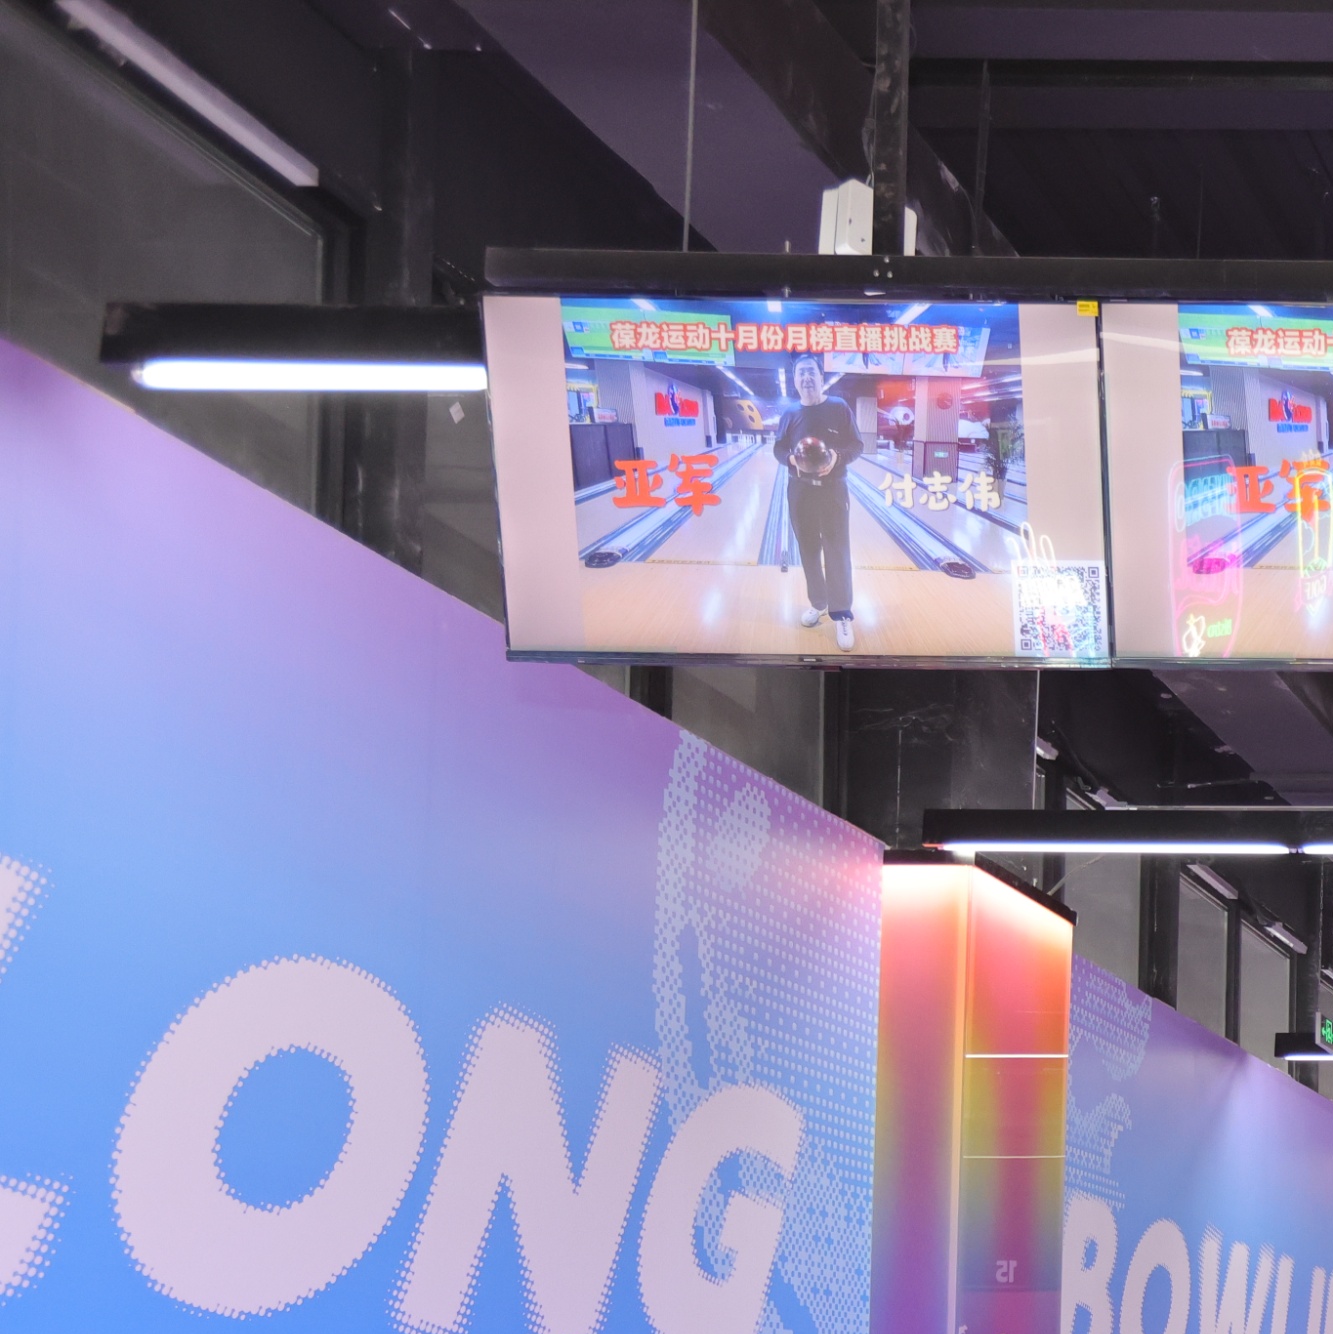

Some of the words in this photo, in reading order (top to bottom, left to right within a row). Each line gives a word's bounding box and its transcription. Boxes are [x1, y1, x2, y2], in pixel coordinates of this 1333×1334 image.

[610, 321, 960, 354] 葆龙运动十月份月榜直播挑战赛
[612, 453, 721, 516] 亚军
[881, 472, 1003, 512] 付志伟
[1225, 459, 1332, 523] 亚军
